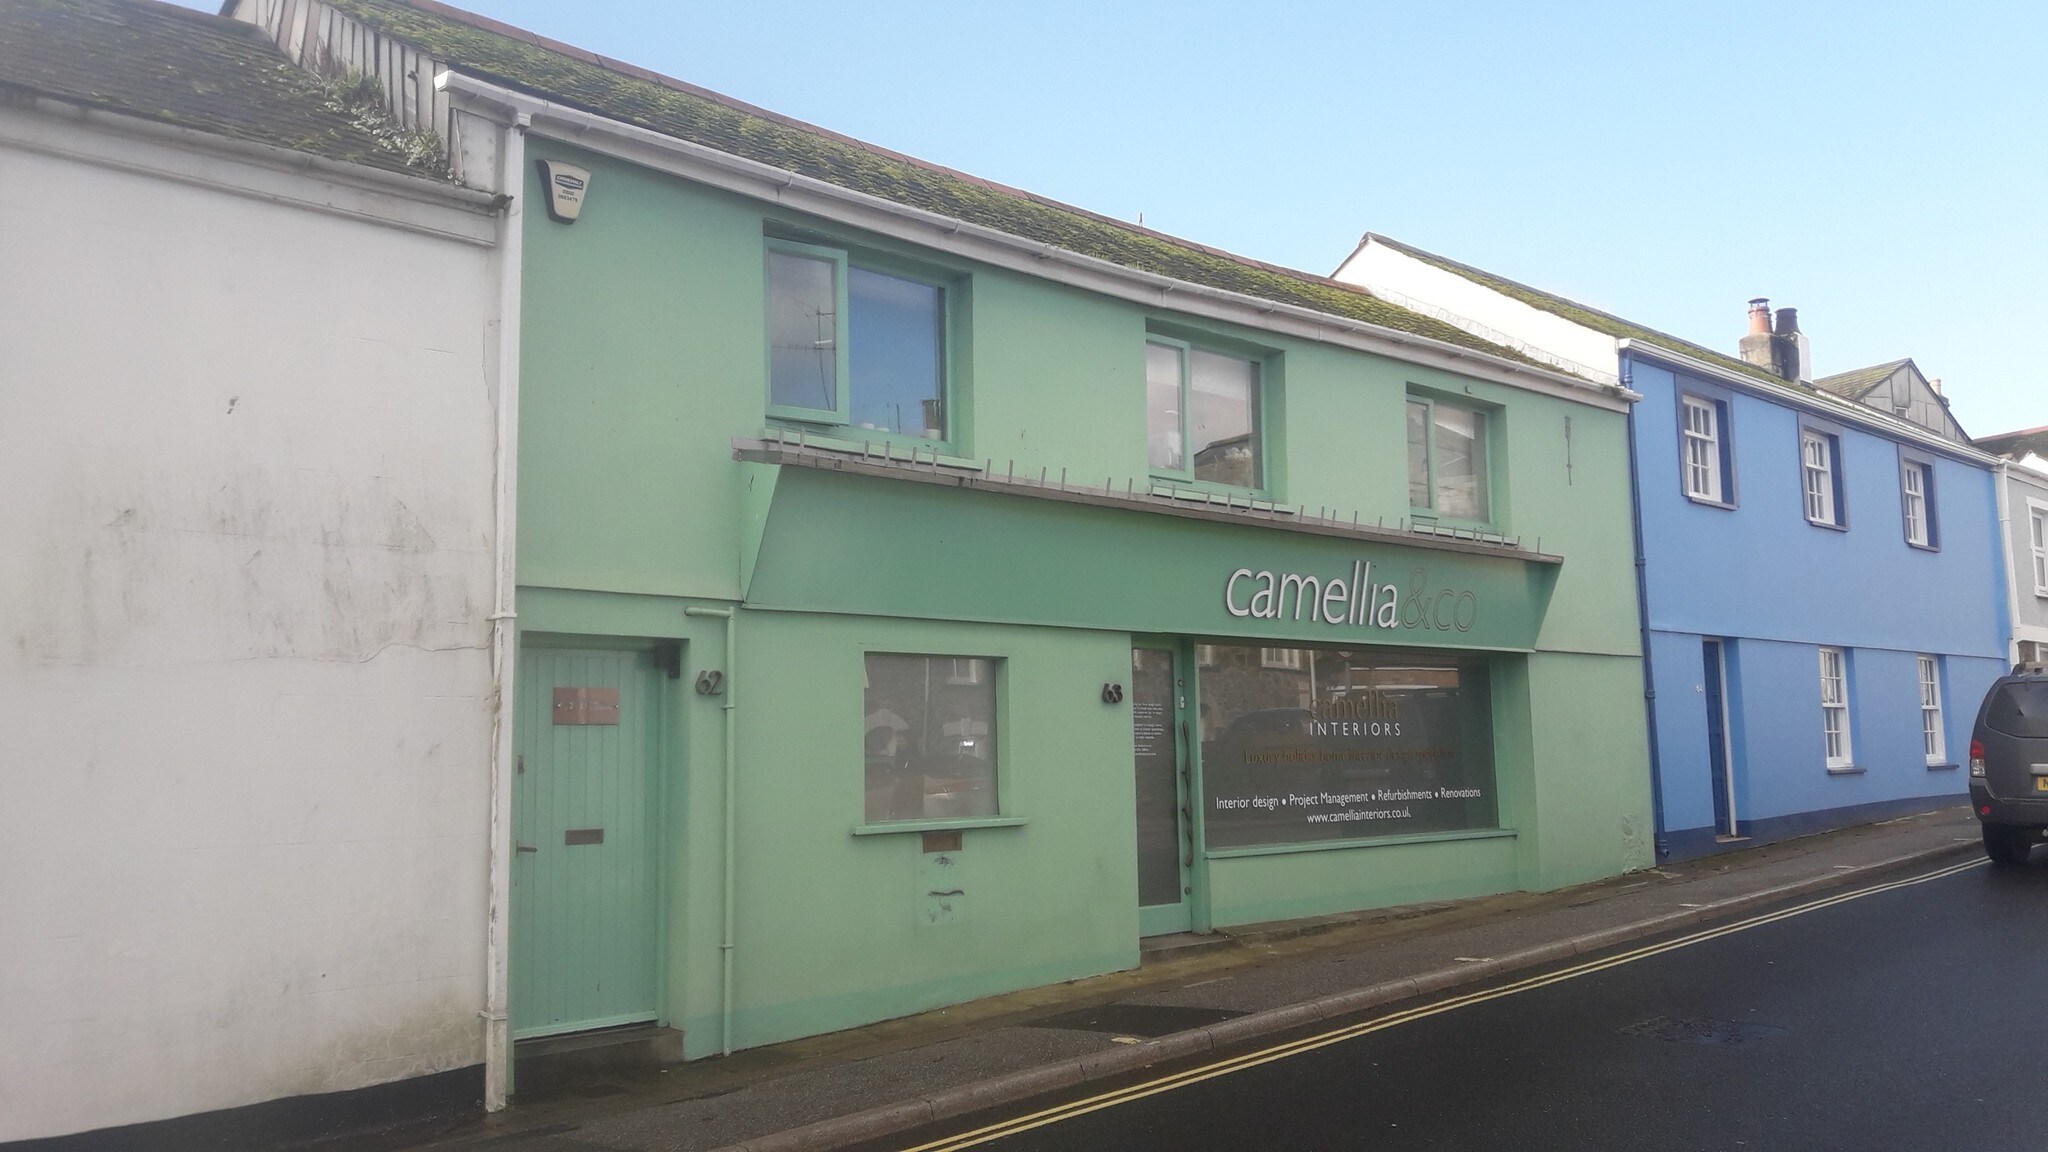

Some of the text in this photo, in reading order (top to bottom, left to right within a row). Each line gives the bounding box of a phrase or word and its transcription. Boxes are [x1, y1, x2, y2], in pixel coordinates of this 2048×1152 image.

[695, 670, 723, 696] 62
[1309, 688, 1399, 720] camellia
[1309, 722, 1401, 736] INTERIORS
[1216, 787, 1482, 810] Interior design Project Management Refurbishments Renovations
[1306, 806, 1412, 824] www.camelliainteriors.co.uk
